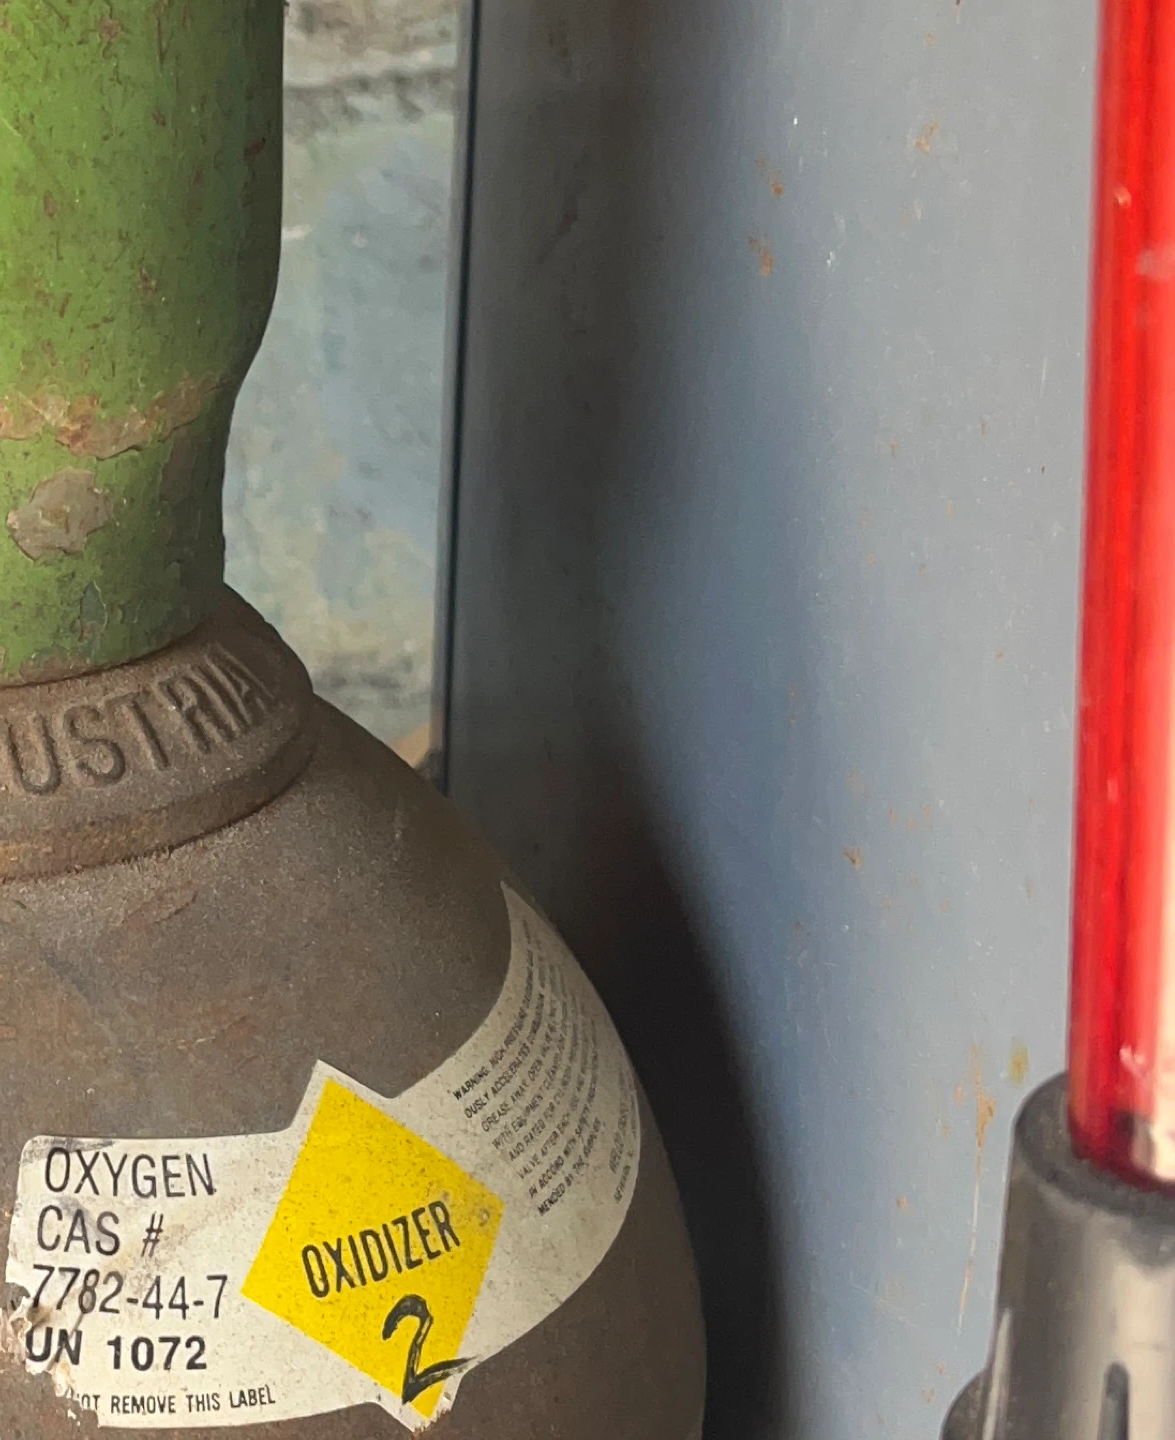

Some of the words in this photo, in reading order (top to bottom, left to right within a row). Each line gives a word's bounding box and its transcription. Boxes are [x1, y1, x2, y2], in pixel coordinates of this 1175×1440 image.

[464, 1091, 490, 1119] OUSLY
[44, 1146, 215, 1199] OXYGEN
[36, 1203, 121, 1257] CAS
[140, 1210, 164, 1258] #
[301, 1200, 461, 1299] OXIDIZER
[31, 1263, 229, 1321] 7782-44-7
[26, 1326, 83, 1366] UN
[106, 1334, 208, 1372] 1072
[381, 1292, 483, 1405] 2
[110, 1394, 176, 1415] REMOVE
[185, 1393, 221, 1412] THIS
[228, 1383, 276, 1409] LABEL
